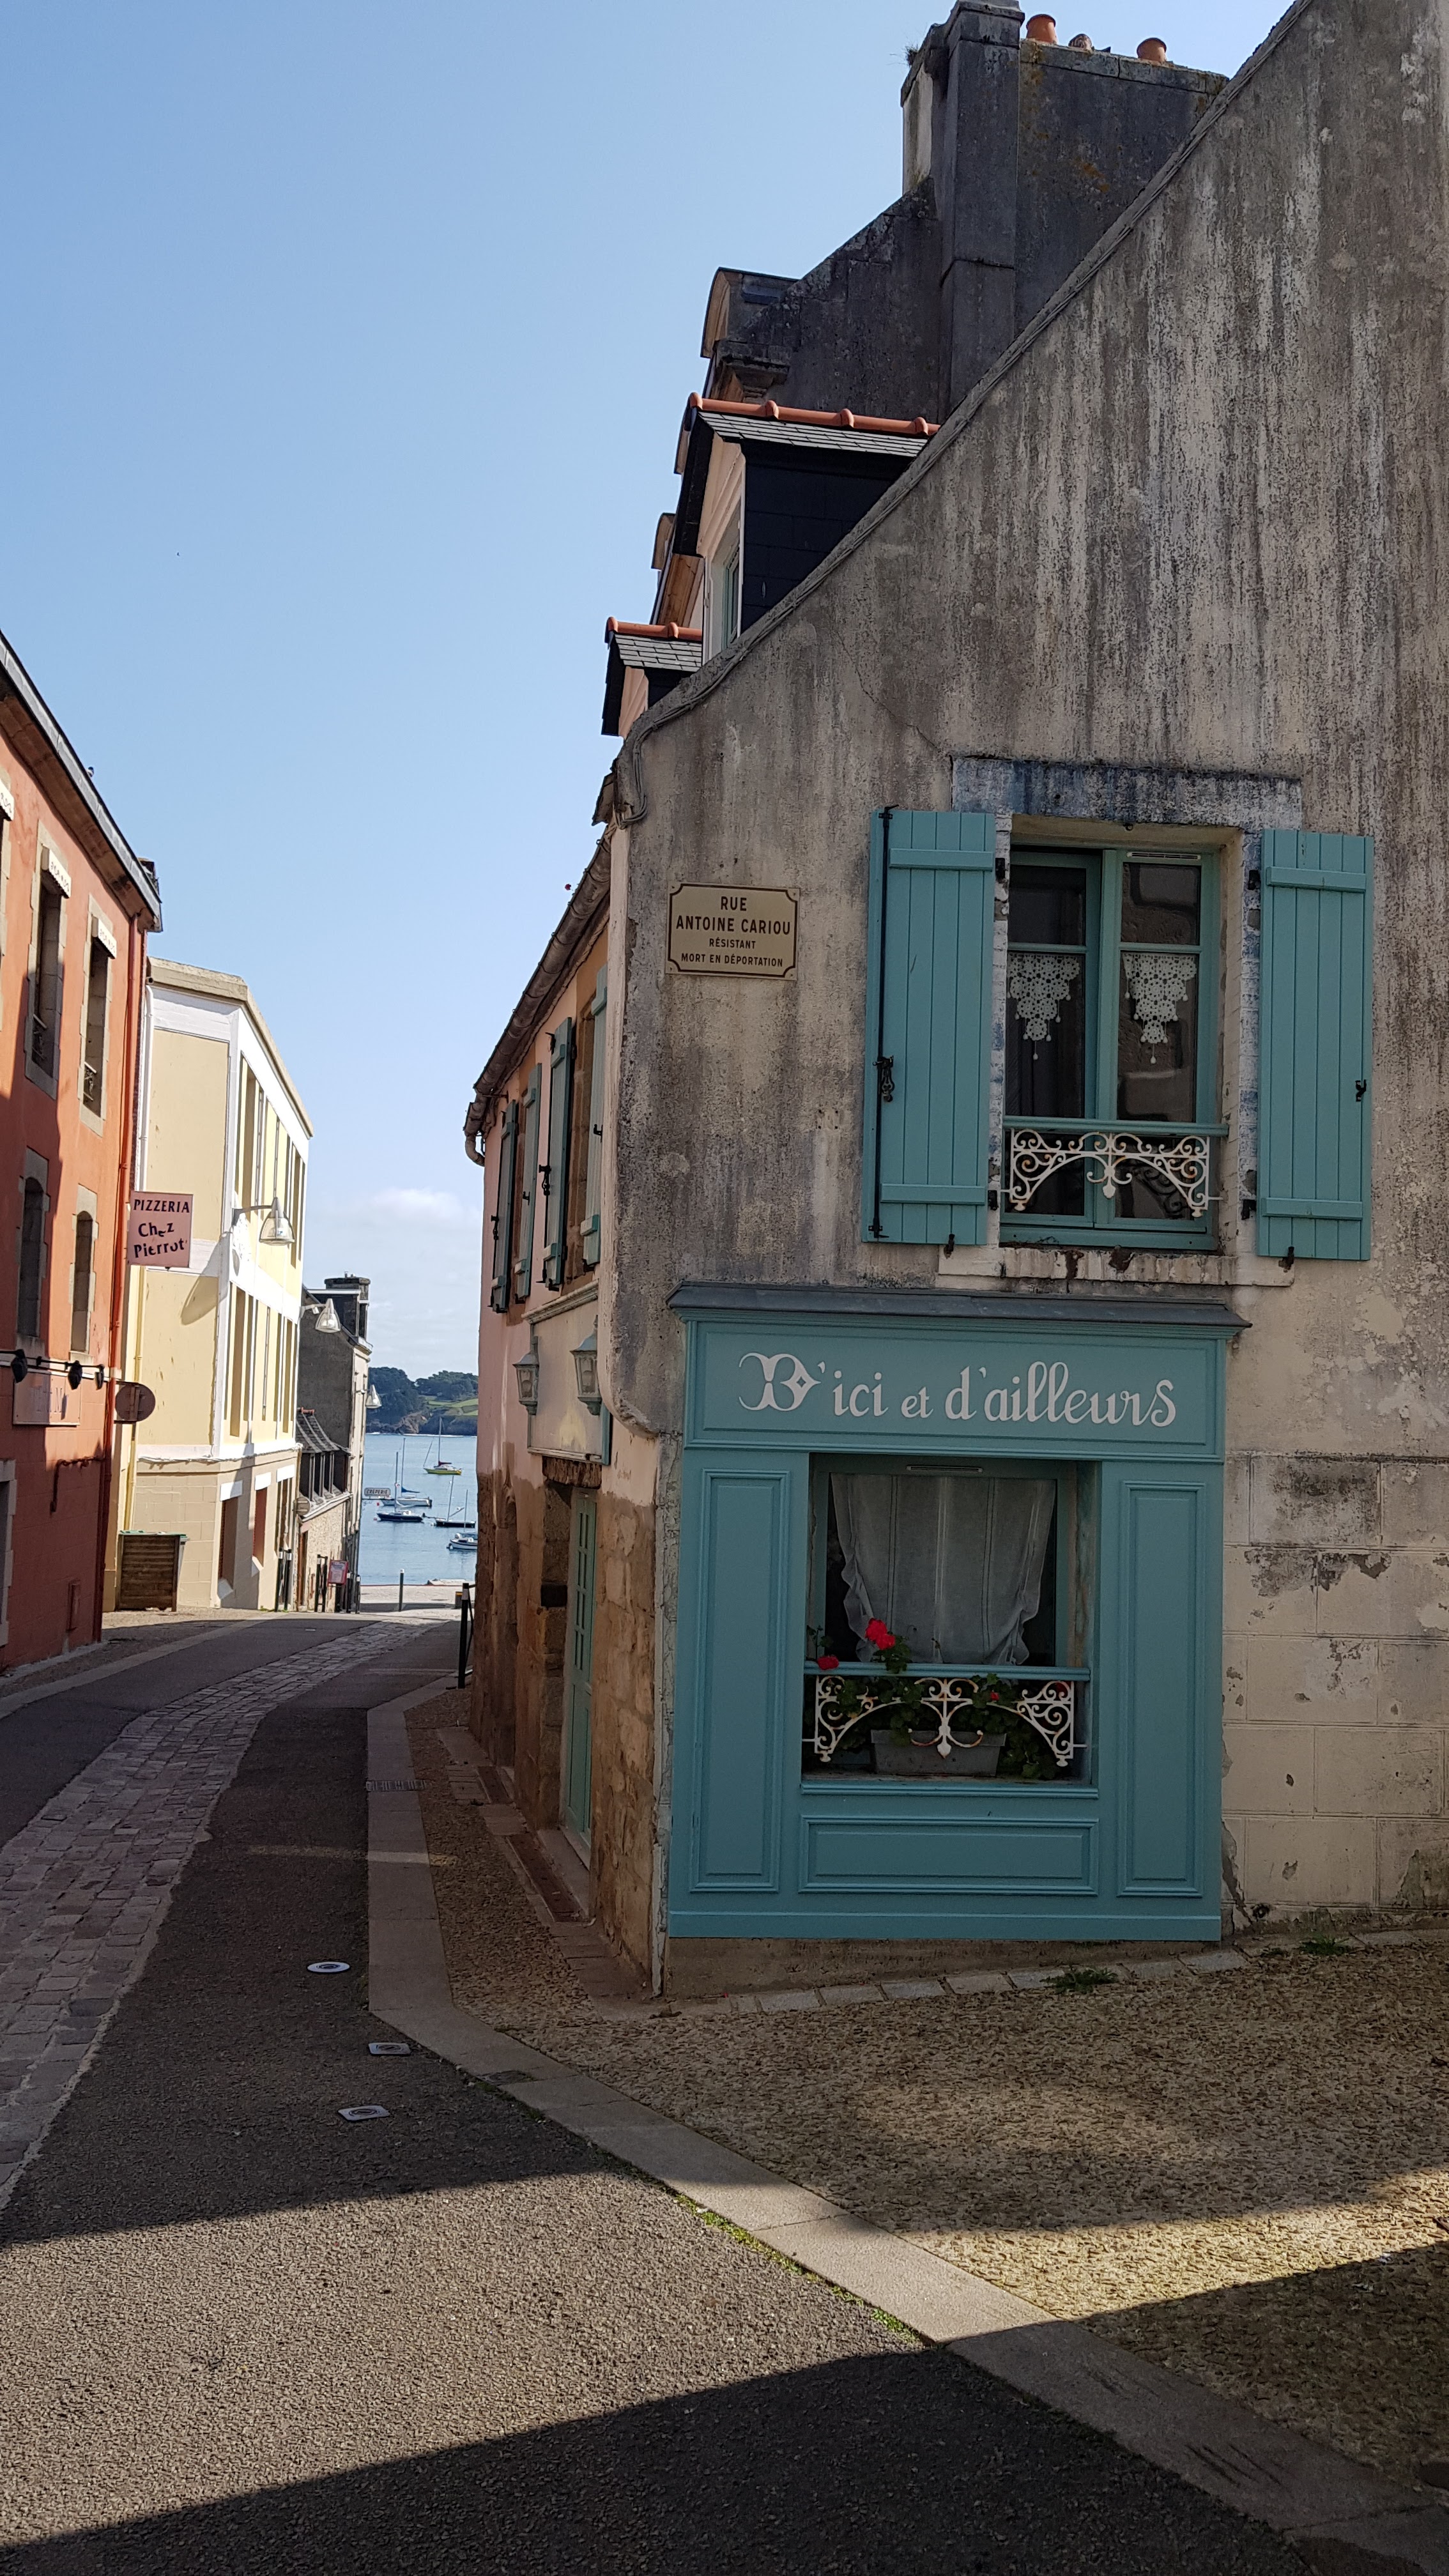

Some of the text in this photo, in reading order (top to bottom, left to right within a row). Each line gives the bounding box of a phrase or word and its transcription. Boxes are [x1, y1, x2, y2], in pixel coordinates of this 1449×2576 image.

[721, 896, 747, 911] RUE
[676, 916, 790, 935] ANTOINE CARIOU
[709, 937, 756, 949] RÉSISTANT
[681, 953, 783, 967] MORT EN DÉPORTATION
[134, 1199, 190, 1213] PIZZERIA
[138, 1222, 174, 1237] Chez
[134, 1238, 184, 1258] Pierrot
[739, 1352, 1177, 1427] D'ici et d'ailleurs
